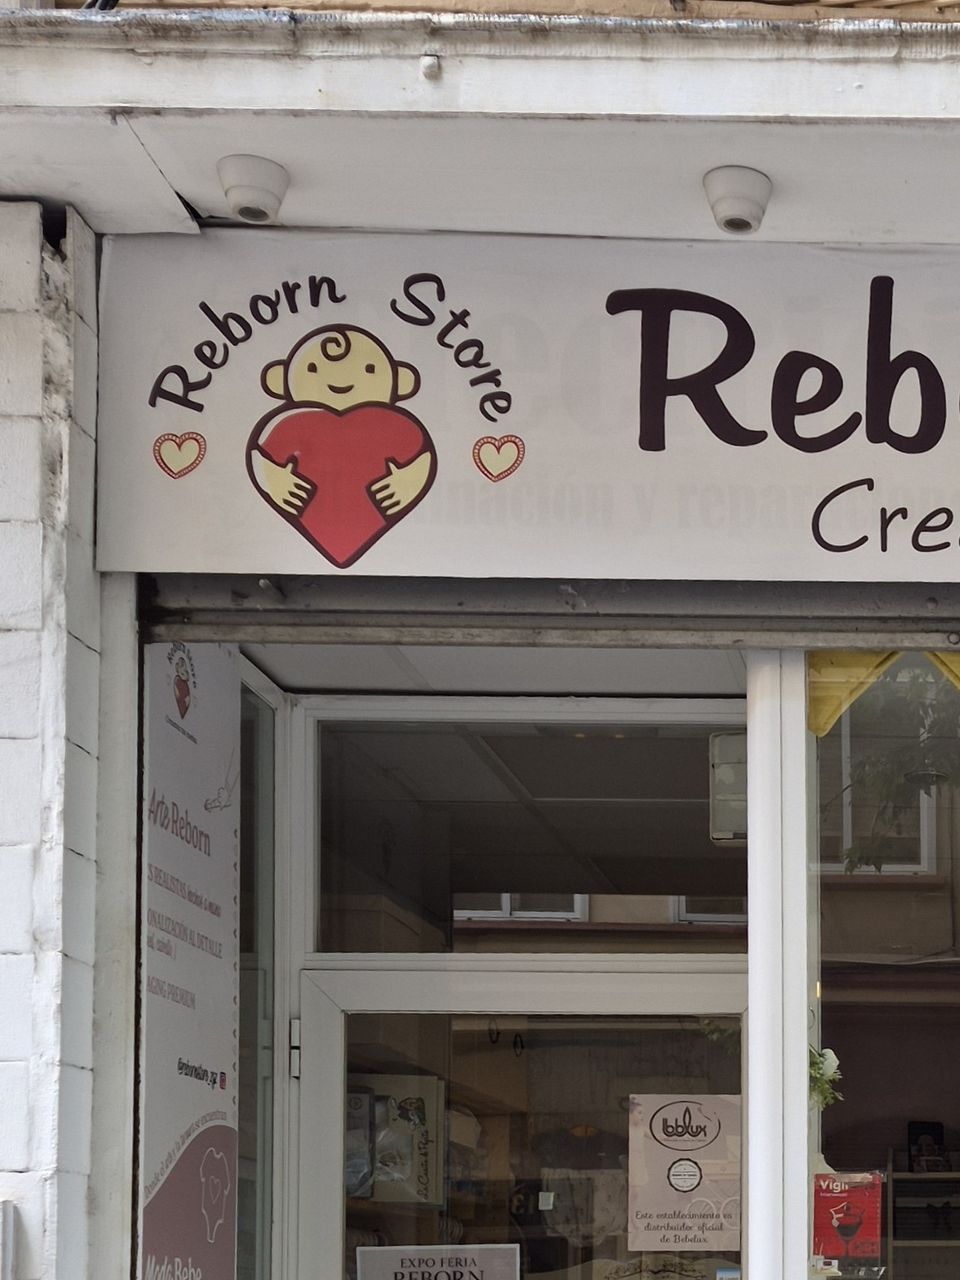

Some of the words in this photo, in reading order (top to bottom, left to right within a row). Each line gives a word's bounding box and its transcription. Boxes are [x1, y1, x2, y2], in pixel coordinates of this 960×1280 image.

[149, 275, 347, 413] Reborn
[390, 272, 513, 422] Store
[148, 786, 170, 830] Arte
[171, 801, 211, 858] Reborn
[635, 1210, 653, 1220] Este
[656, 1210, 721, 1220] establecimiento
[643, 1222, 693, 1232] distribuidor
[697, 1221, 724, 1235] oficial
[659, 1234, 670, 1244] de
[400, 1257, 436, 1269] EXPO
[440, 1256, 478, 1268] FERIA
